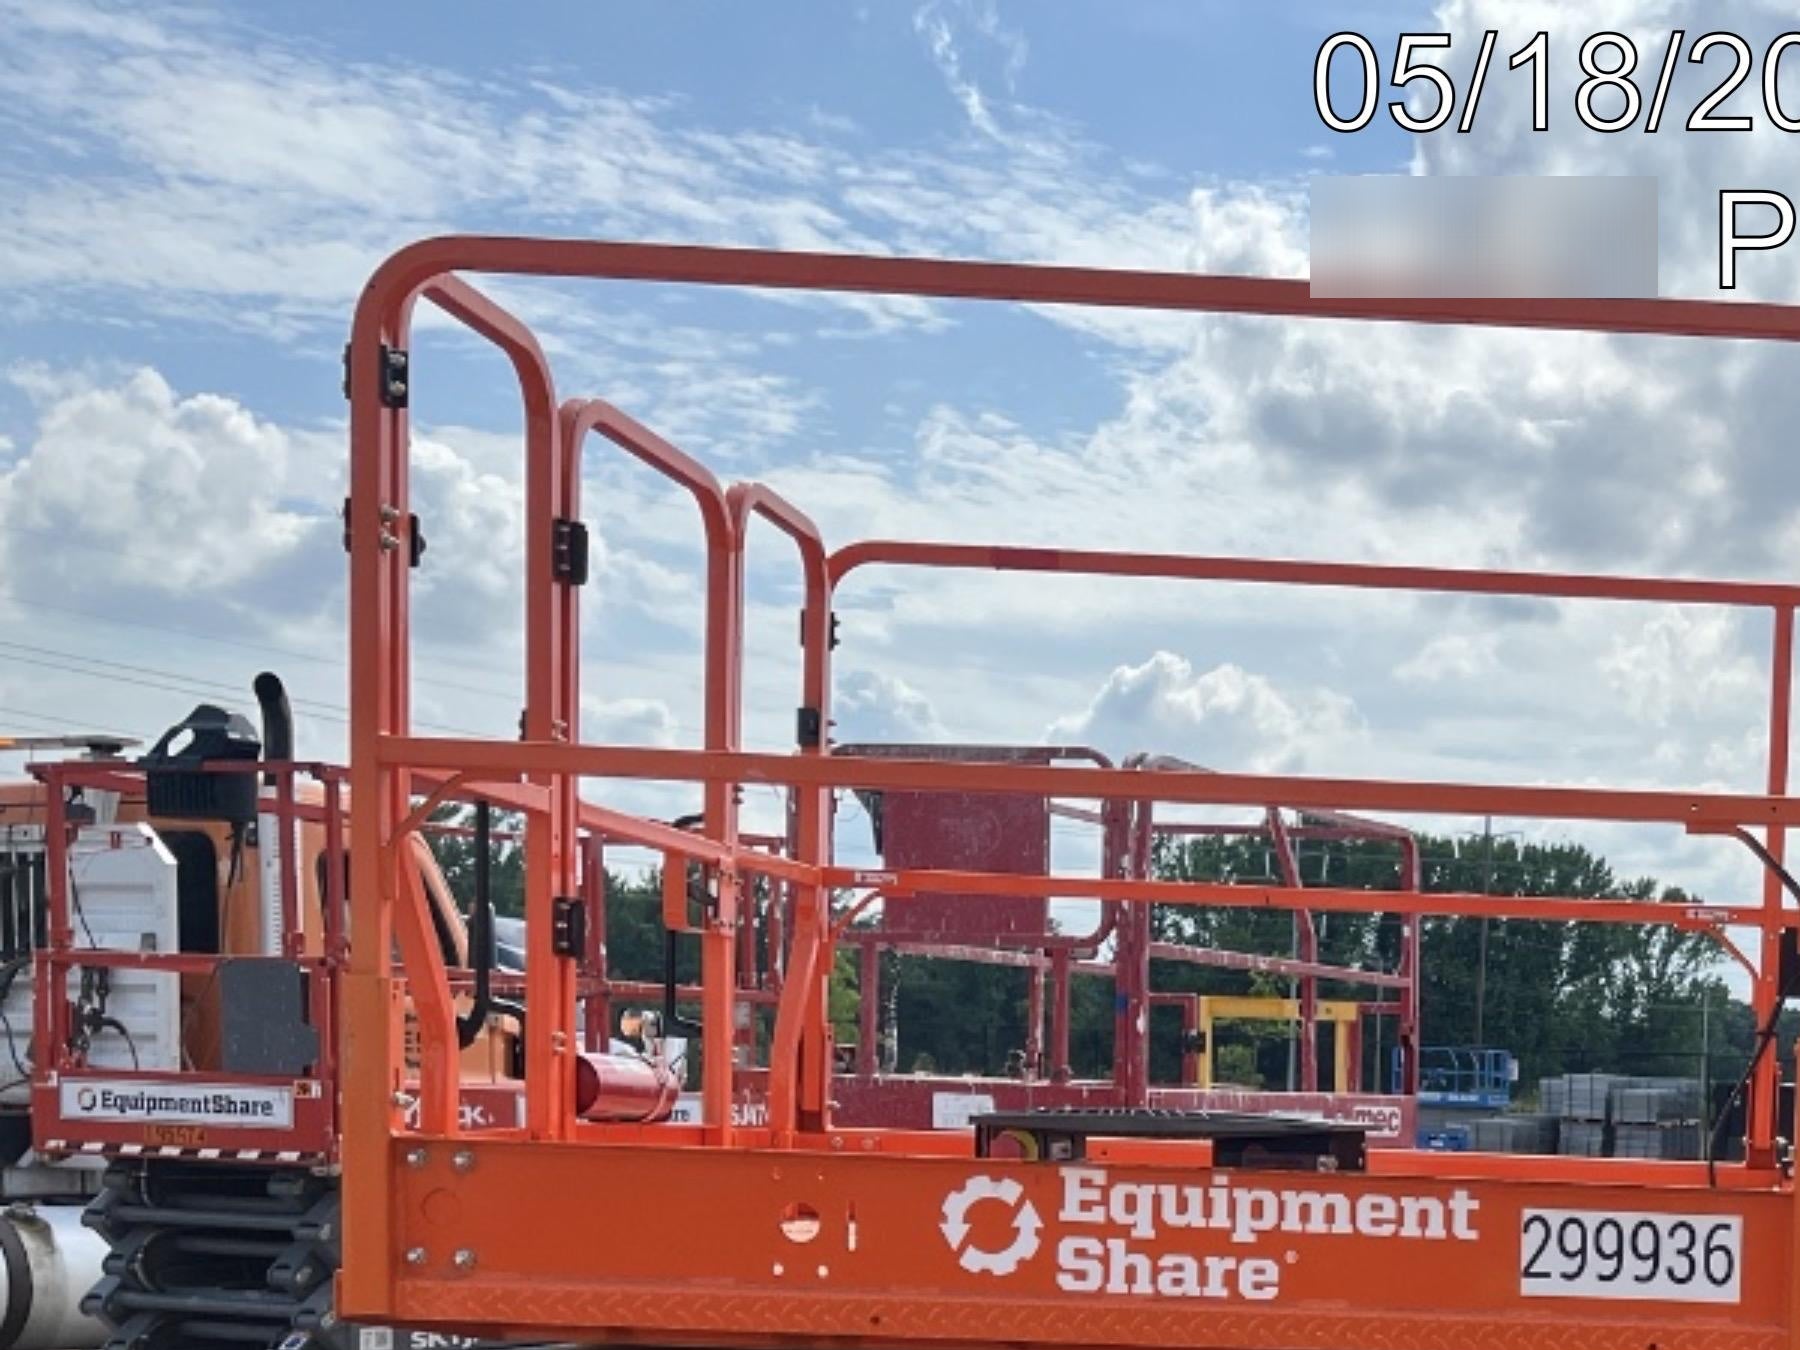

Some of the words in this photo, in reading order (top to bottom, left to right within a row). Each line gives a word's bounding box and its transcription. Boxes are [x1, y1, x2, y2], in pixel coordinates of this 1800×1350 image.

[101, 1090, 275, 1117] EquipmentShare
[1057, 1166, 1481, 1243] Equipment
[1522, 1214, 1735, 1288] 299936
